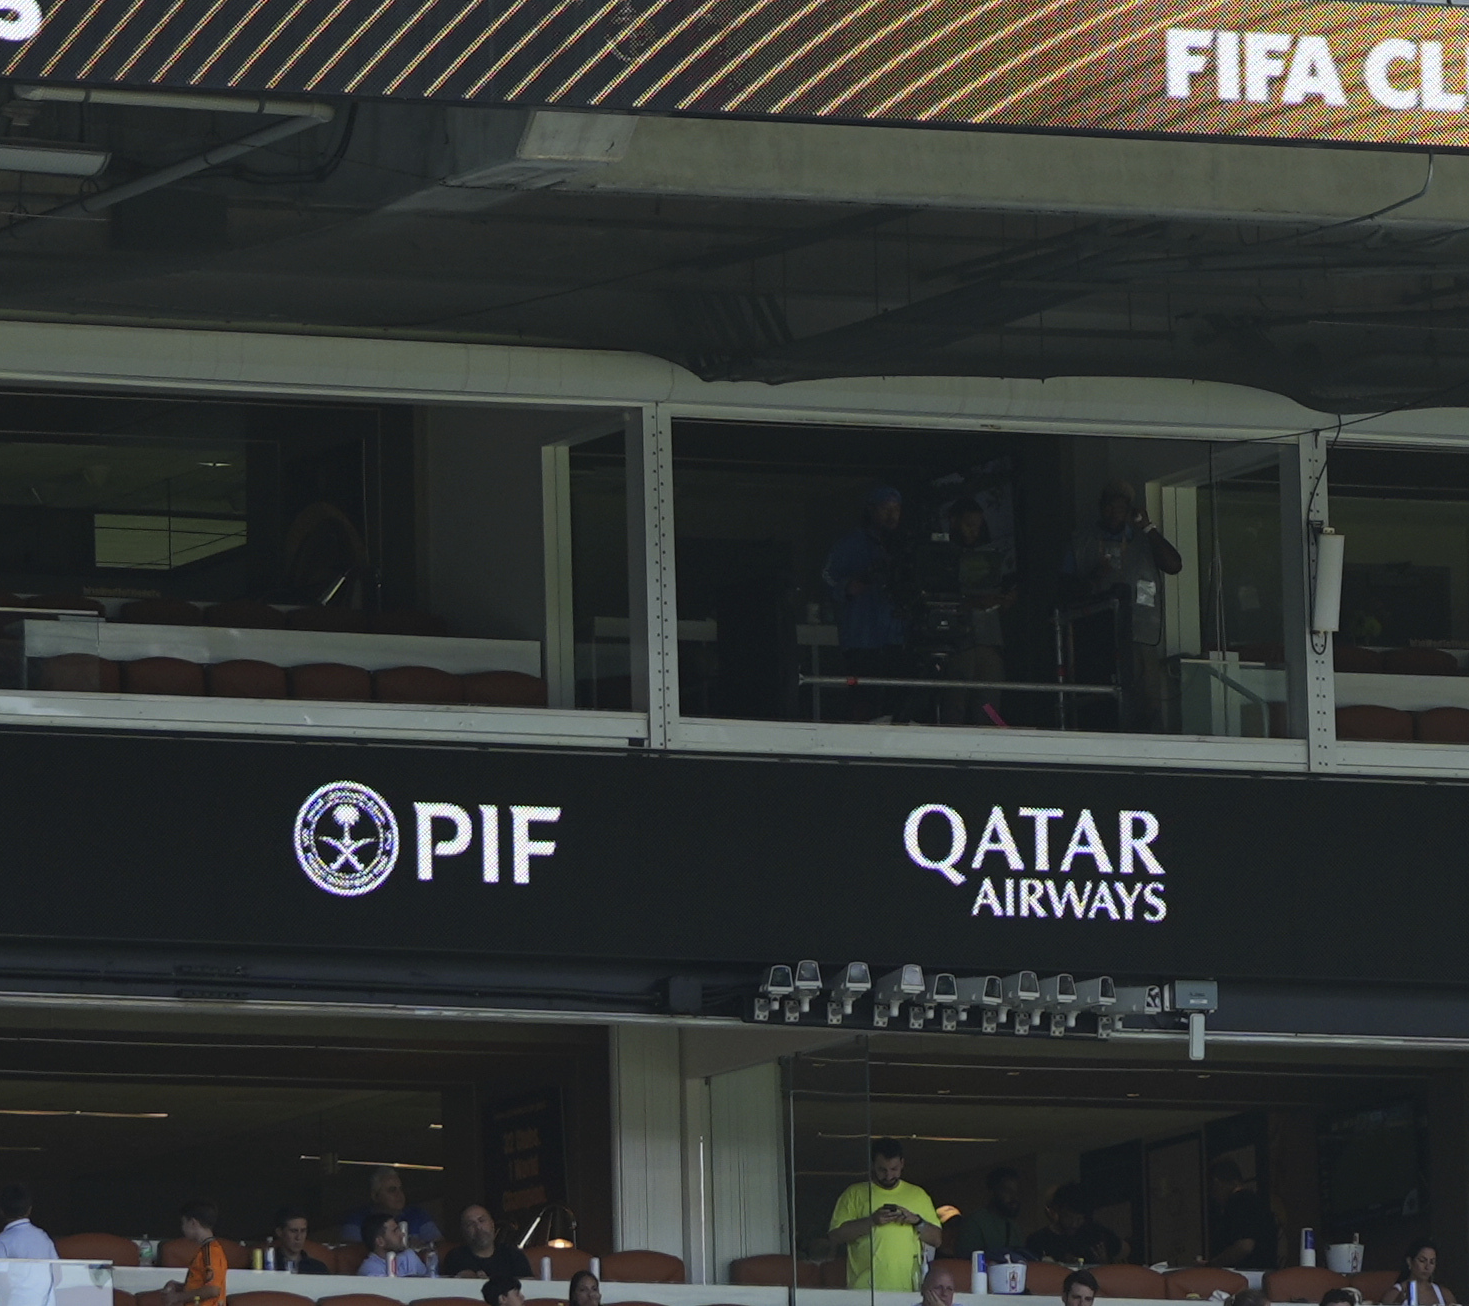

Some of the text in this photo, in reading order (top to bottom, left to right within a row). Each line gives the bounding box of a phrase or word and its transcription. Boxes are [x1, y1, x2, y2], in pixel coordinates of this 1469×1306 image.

[1167, 29, 1347, 106] FIFA
[414, 802, 561, 883] PIF
[904, 803, 1166, 885] QATAR
[971, 876, 1166, 922] AIRWAYS
